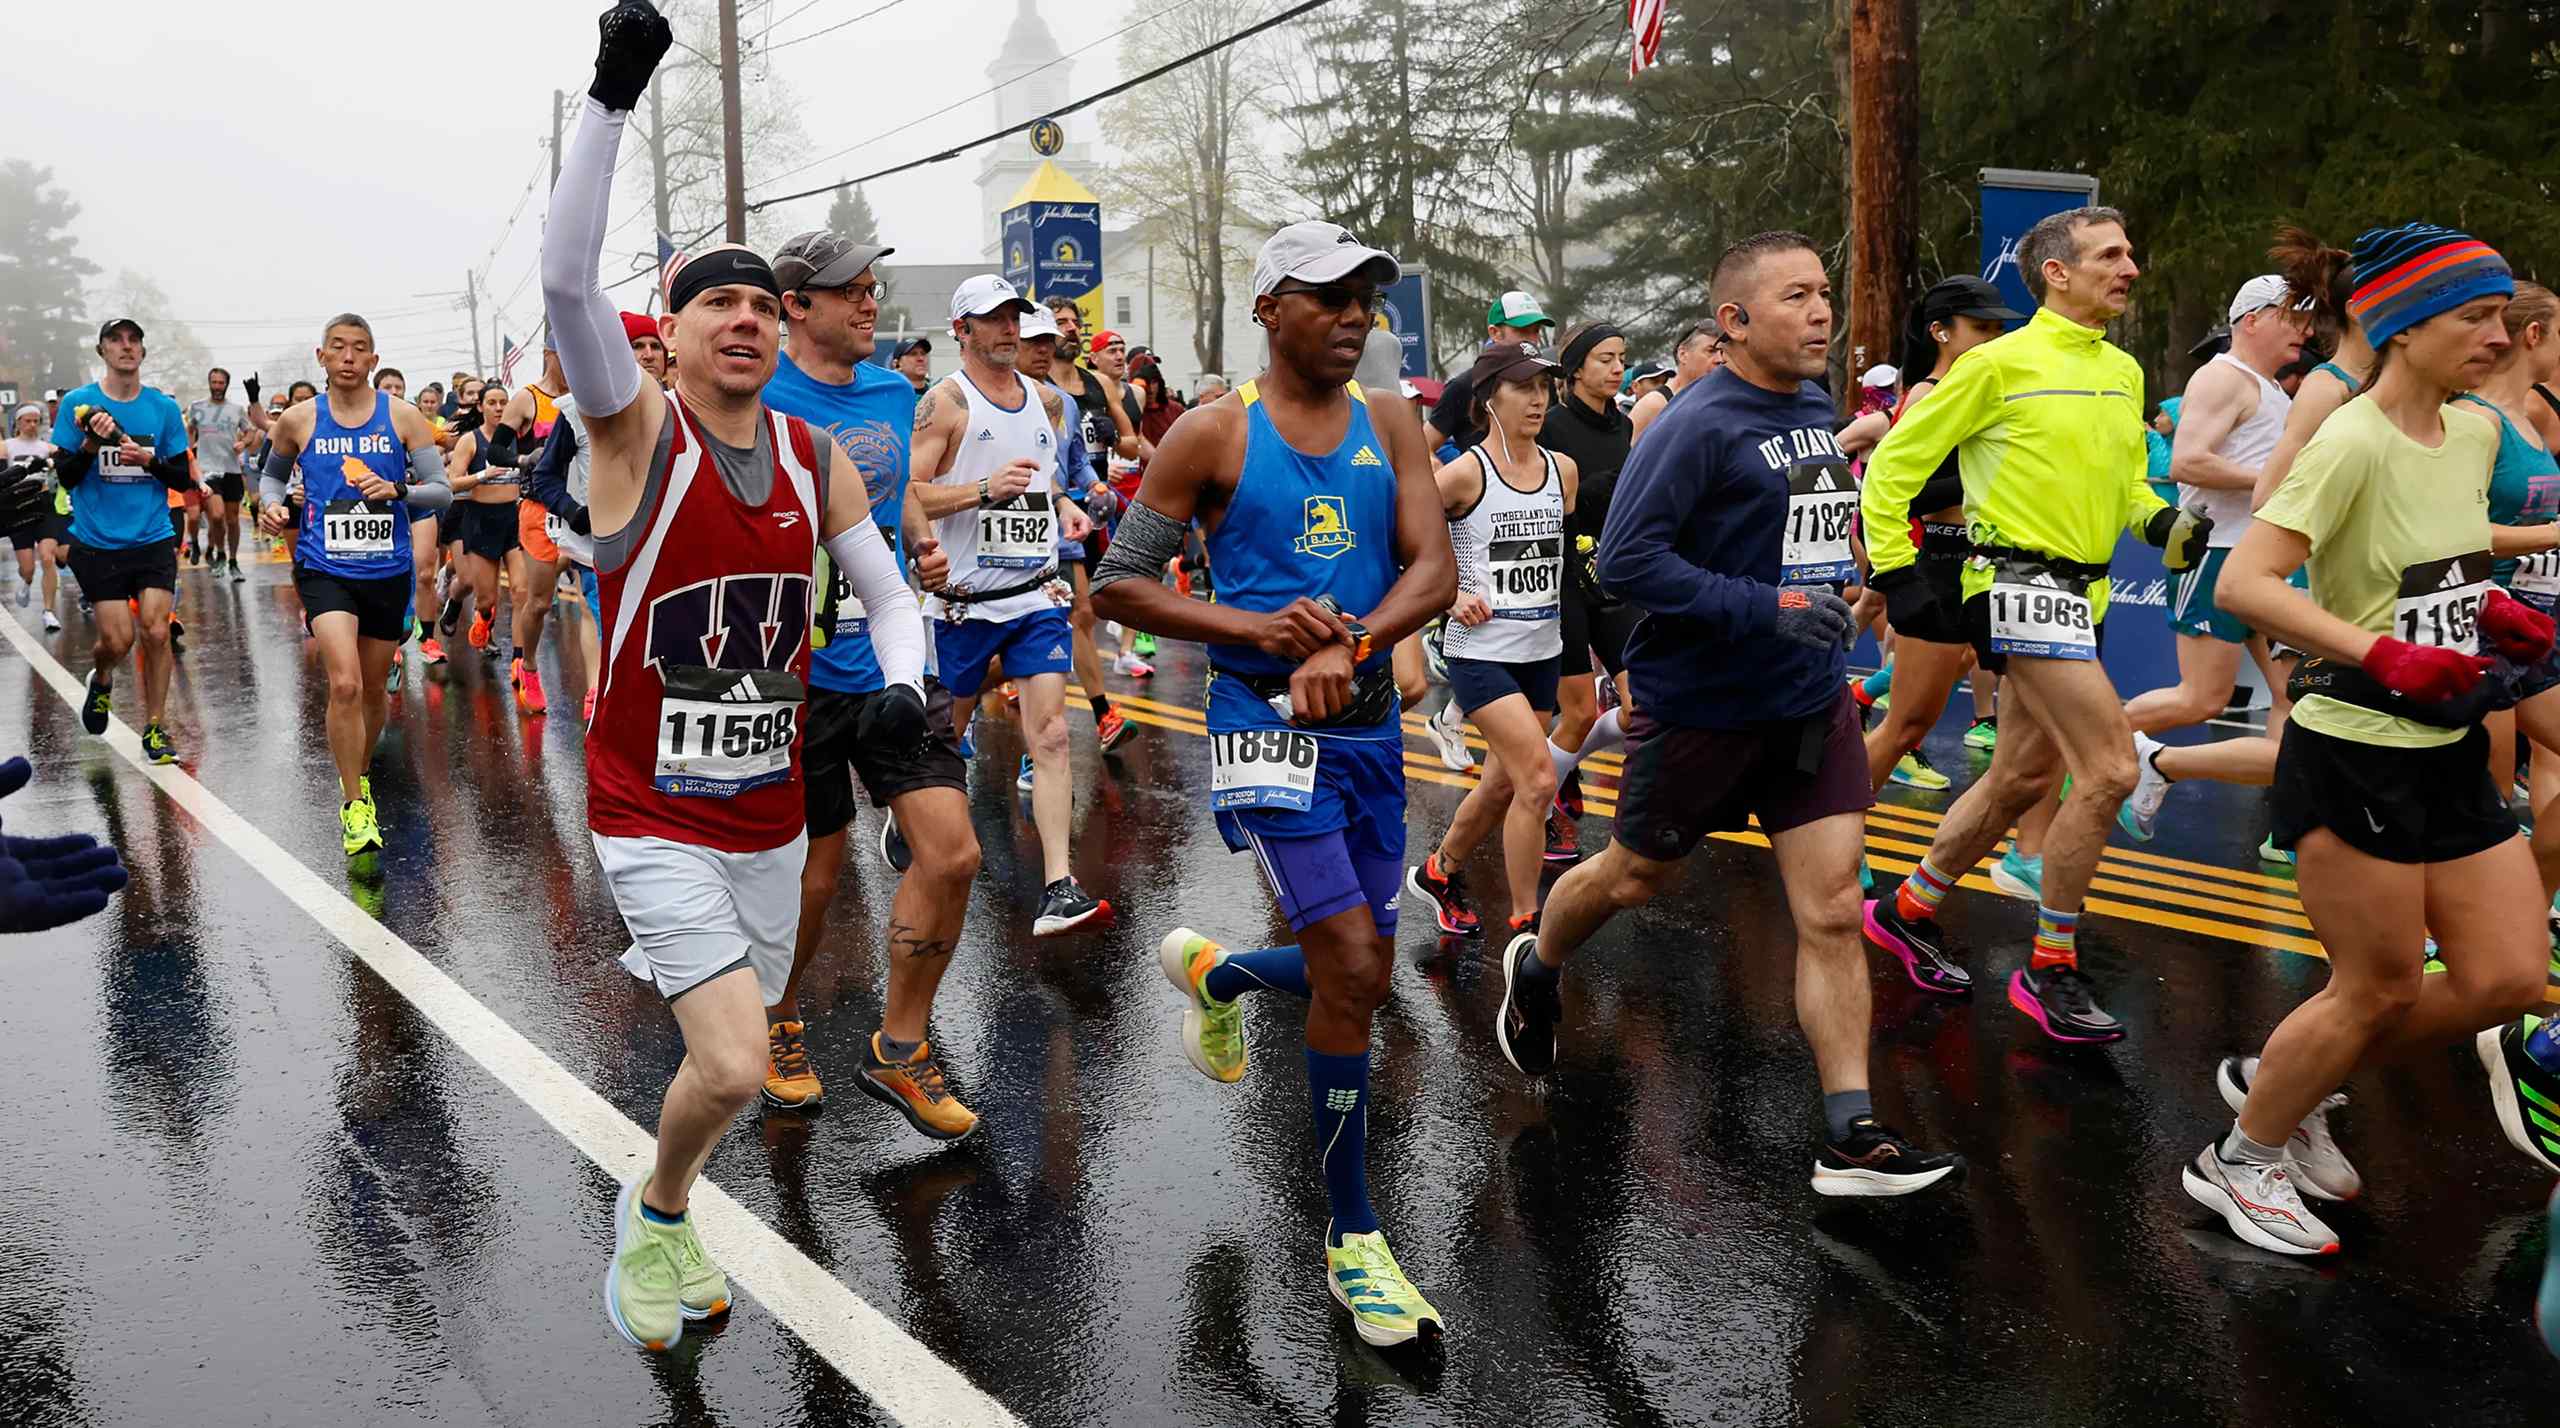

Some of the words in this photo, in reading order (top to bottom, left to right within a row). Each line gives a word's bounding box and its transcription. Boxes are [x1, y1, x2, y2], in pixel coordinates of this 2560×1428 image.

[315, 437, 353, 455] RUN
[1758, 434, 1792, 470] UC
[327, 519, 392, 541] 11898
[981, 517, 1049, 543] 11532
[1490, 508, 1543, 524] CUMBERLAND
[1493, 520, 1546, 540] ATHLETIC
[1310, 533, 1347, 545] B.A.A.
[1492, 563, 1559, 594] 10081
[1993, 591, 2090, 631] 11963
[2400, 593, 2485, 646] 1165
[667, 707, 794, 758] 11598
[1214, 731, 1315, 769] 11896
